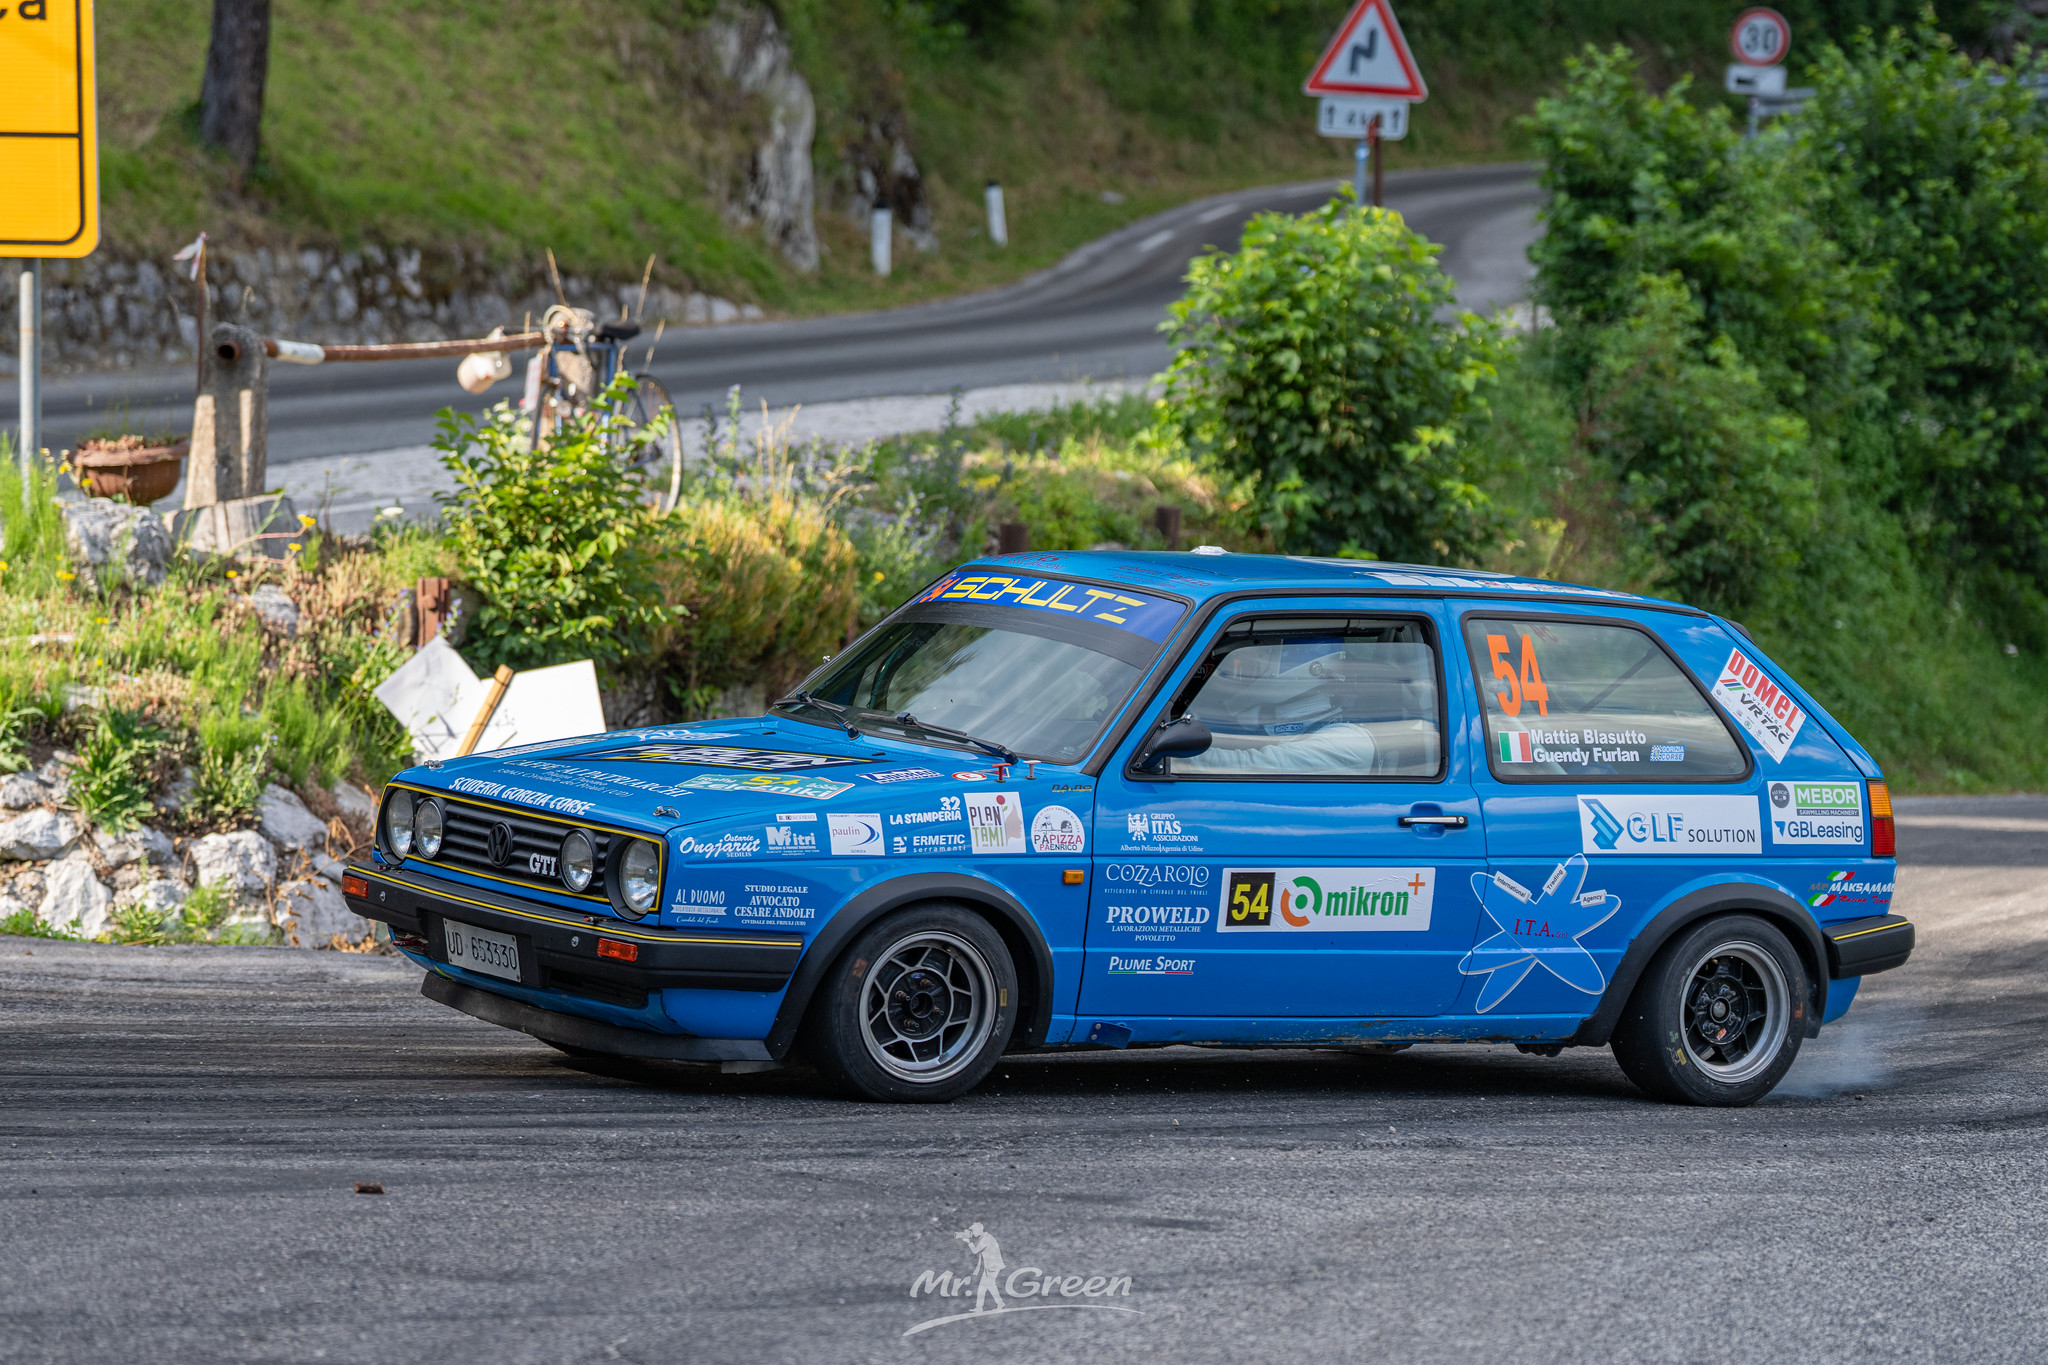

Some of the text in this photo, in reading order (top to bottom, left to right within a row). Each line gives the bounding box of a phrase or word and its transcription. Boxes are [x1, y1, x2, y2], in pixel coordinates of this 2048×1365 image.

[1745, 24, 1778, 54] 30
[942, 576, 1147, 625] SCHULTZ
[1486, 634, 1549, 717] 54
[1530, 728, 1647, 745] Mattia Blasutto
[1533, 747, 1640, 765] Guendy Furlan
[1661, 753, 1683, 761] CORSE
[582, 767, 694, 798] PATRIARCHI
[448, 776, 597, 816] SCUDERIA GORIZIA CORSE
[940, 796, 961, 811] 32
[1796, 788, 1857, 804] MEBOR
[890, 809, 962, 826] LA STAMPERIA
[970, 806, 1002, 827] PLAN
[765, 826, 816, 846] Mitri
[832, 826, 860, 837] paulin
[1151, 820, 1182, 835] ITAS
[1626, 812, 1756, 843] GLF SOLUTION
[1787, 821, 1863, 843] GBLeasing
[913, 834, 966, 846] ERMETIC
[972, 826, 1004, 848] TAMI
[1152, 834, 1198, 842] ASSICURAZIONI
[679, 836, 761, 859] Ongjarut
[913, 846, 966, 854] serramenti
[529, 852, 558, 876] GTI
[1106, 864, 1210, 887] COZZAROLO
[1546, 869, 1564, 891] Trading
[744, 884, 808, 894] STUDIO LEGALE
[1496, 875, 1527, 898] International
[675, 888, 726, 905] AL DUOMO
[750, 895, 800, 907] AVVOCATO
[1231, 882, 1269, 921] 54
[1325, 886, 1409, 917] mikron
[1583, 893, 1603, 903] Agency
[1839, 895, 1890, 905] Racing Team
[734, 906, 815, 919] CESARE ANDOLFI
[1106, 906, 1210, 924] PROWELD
[1112, 925, 1202, 933] LAVORAZIONI METALLICHE
[1513, 918, 1554, 938] I.T.A.
[1134, 934, 1176, 942] POVOLETTO
[446, 930, 518, 970] UD 653330
